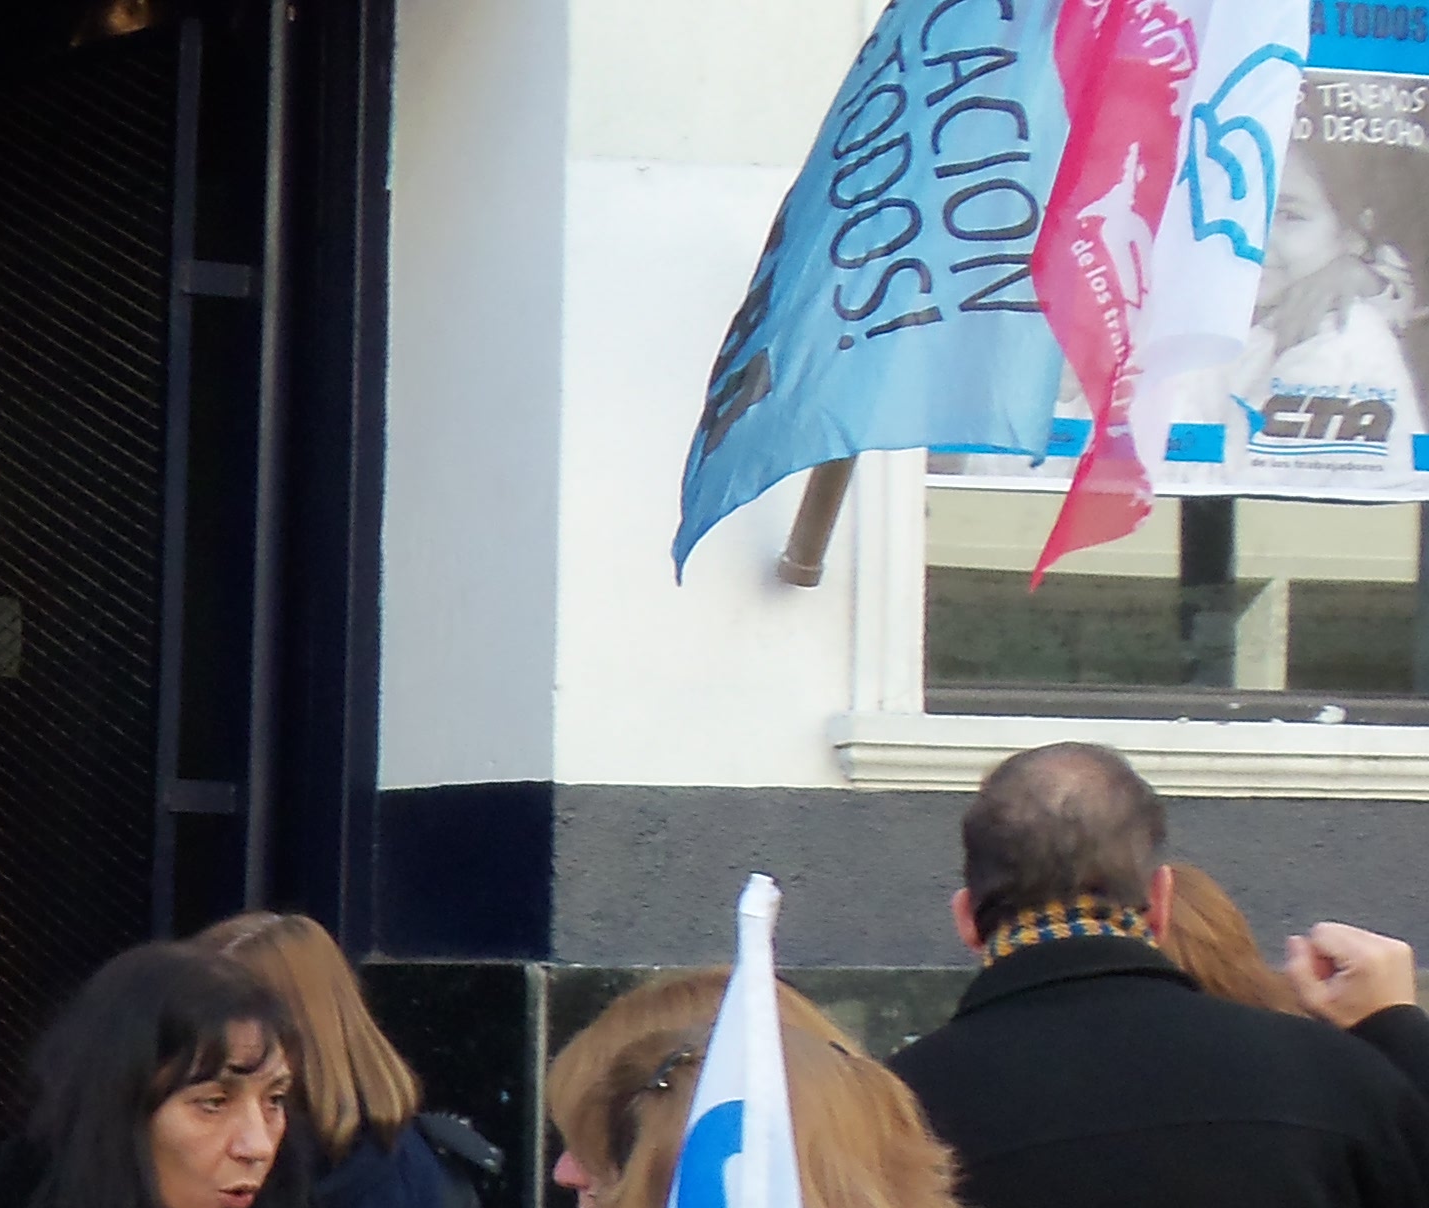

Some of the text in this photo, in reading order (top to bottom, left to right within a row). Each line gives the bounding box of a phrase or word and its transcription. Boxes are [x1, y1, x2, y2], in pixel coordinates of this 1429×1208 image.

[1071, 240, 1094, 267] de
[1086, 265, 1112, 304] los
[1262, 394, 1394, 442] CTA
